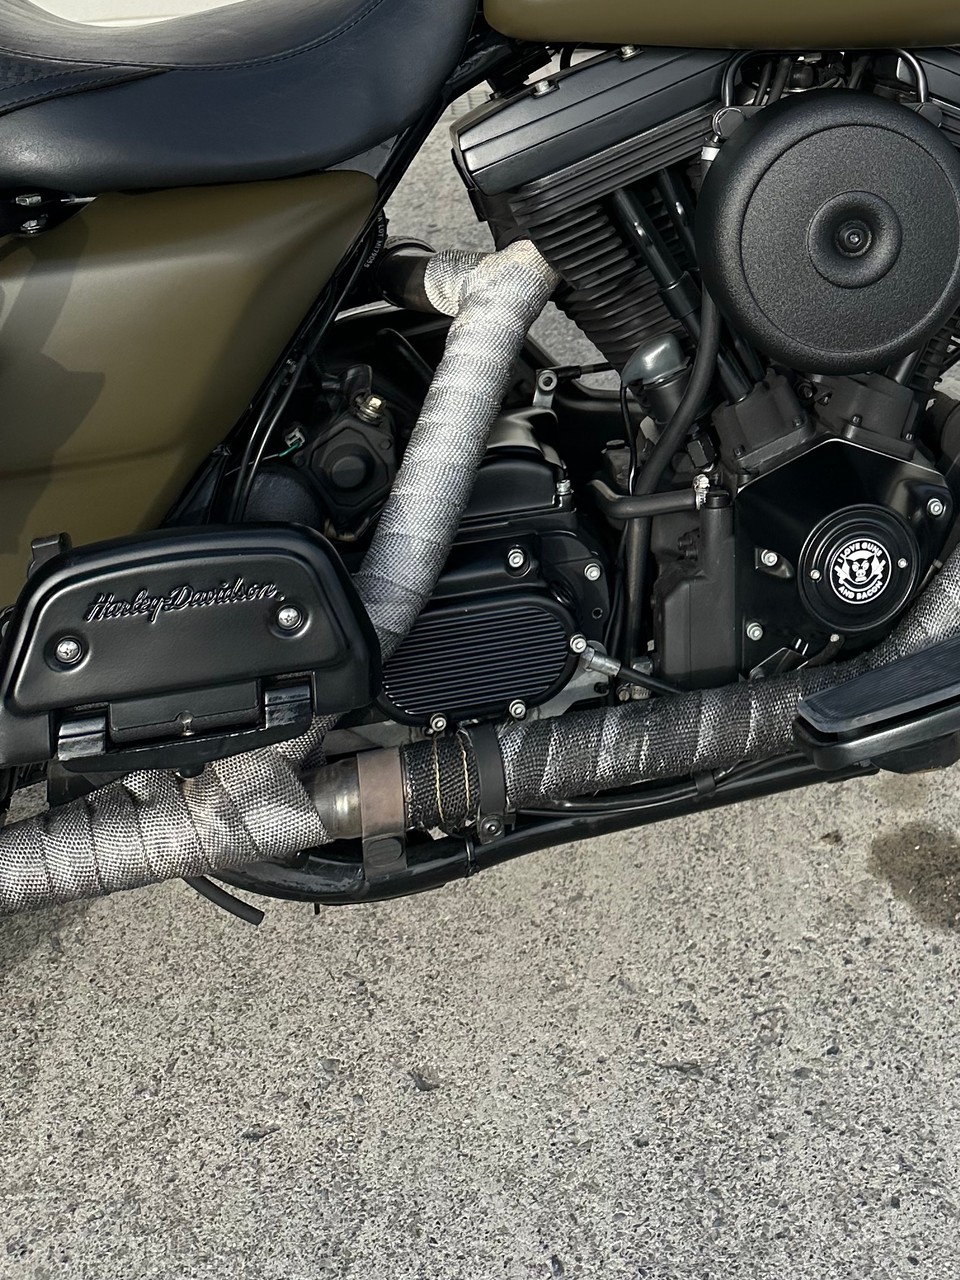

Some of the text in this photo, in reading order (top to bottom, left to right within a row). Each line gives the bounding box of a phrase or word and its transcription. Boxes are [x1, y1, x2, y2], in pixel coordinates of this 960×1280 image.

[840, 542, 861, 558] LOVE
[862, 542, 883, 556] GUNS
[839, 581, 883, 599] AND BACON
[83, 577, 280, 624] Harley-Davidson
